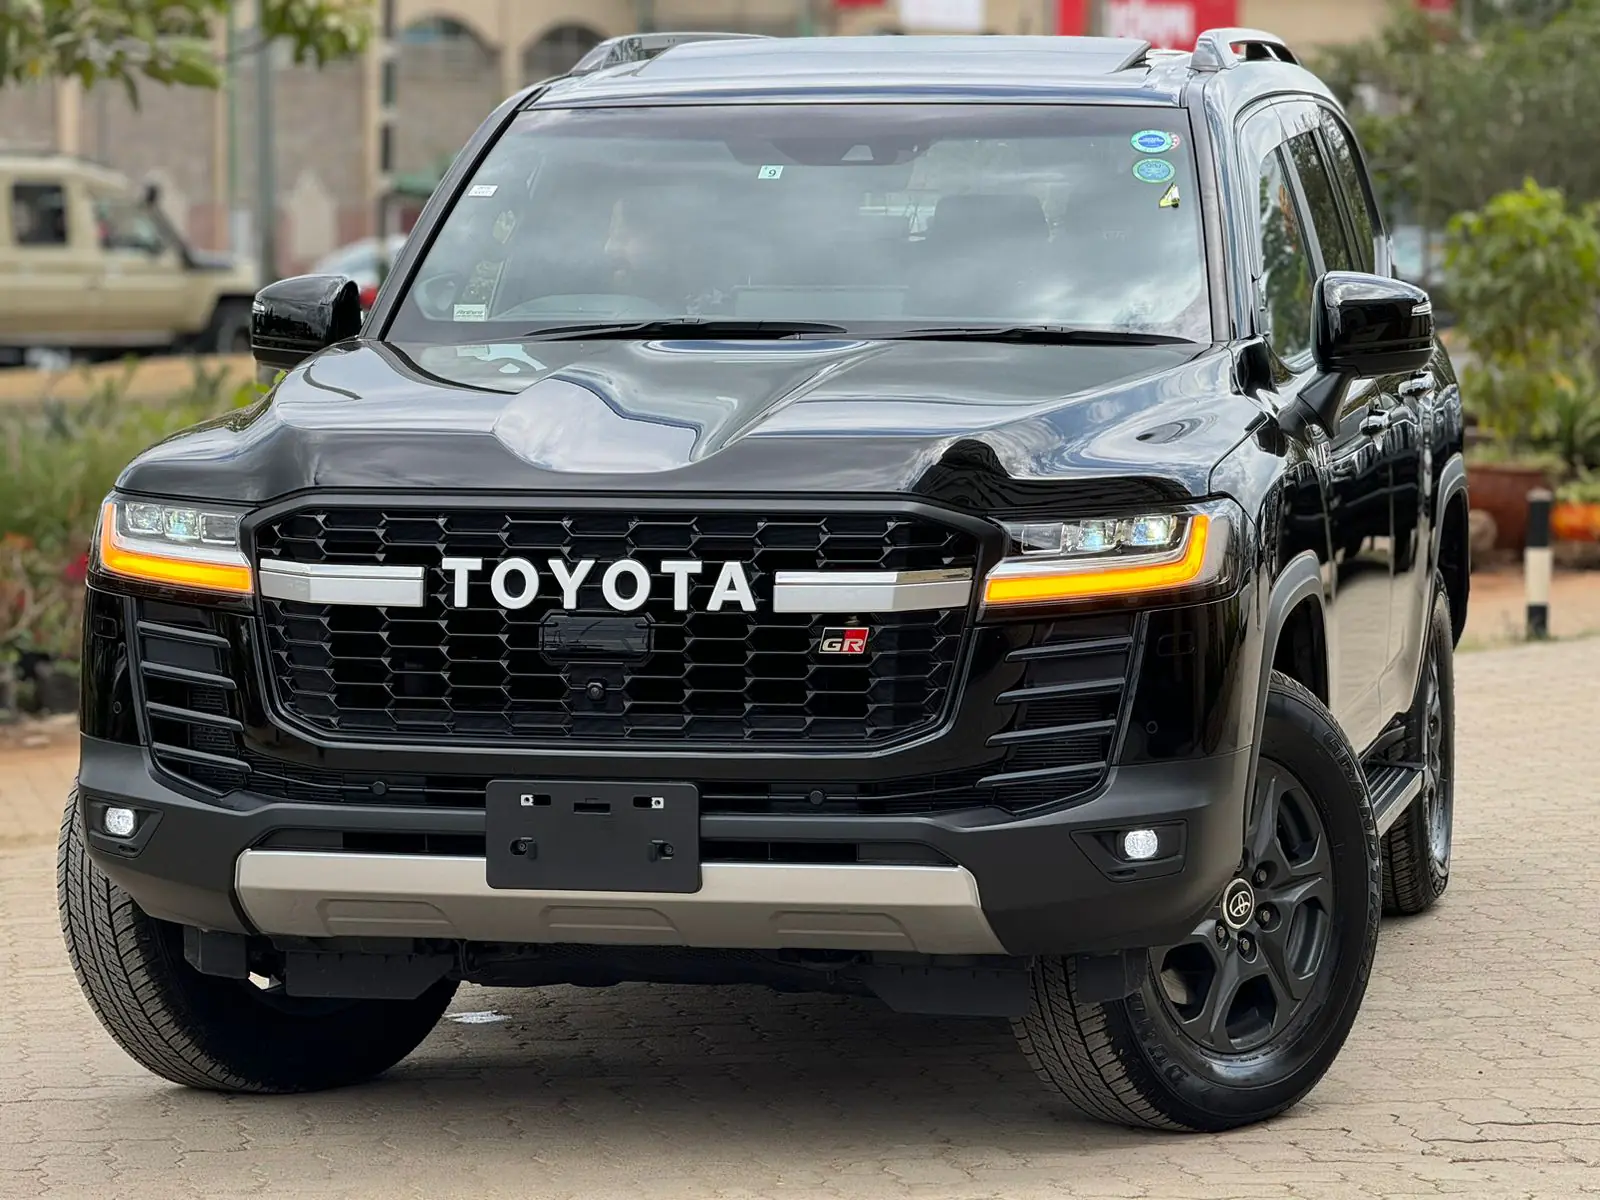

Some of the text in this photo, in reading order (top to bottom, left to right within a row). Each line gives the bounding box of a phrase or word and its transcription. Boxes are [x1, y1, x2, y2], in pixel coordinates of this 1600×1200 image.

[767, 168, 777, 177] 9
[441, 557, 757, 612] TOYOTA
[822, 638, 864, 652] GR
